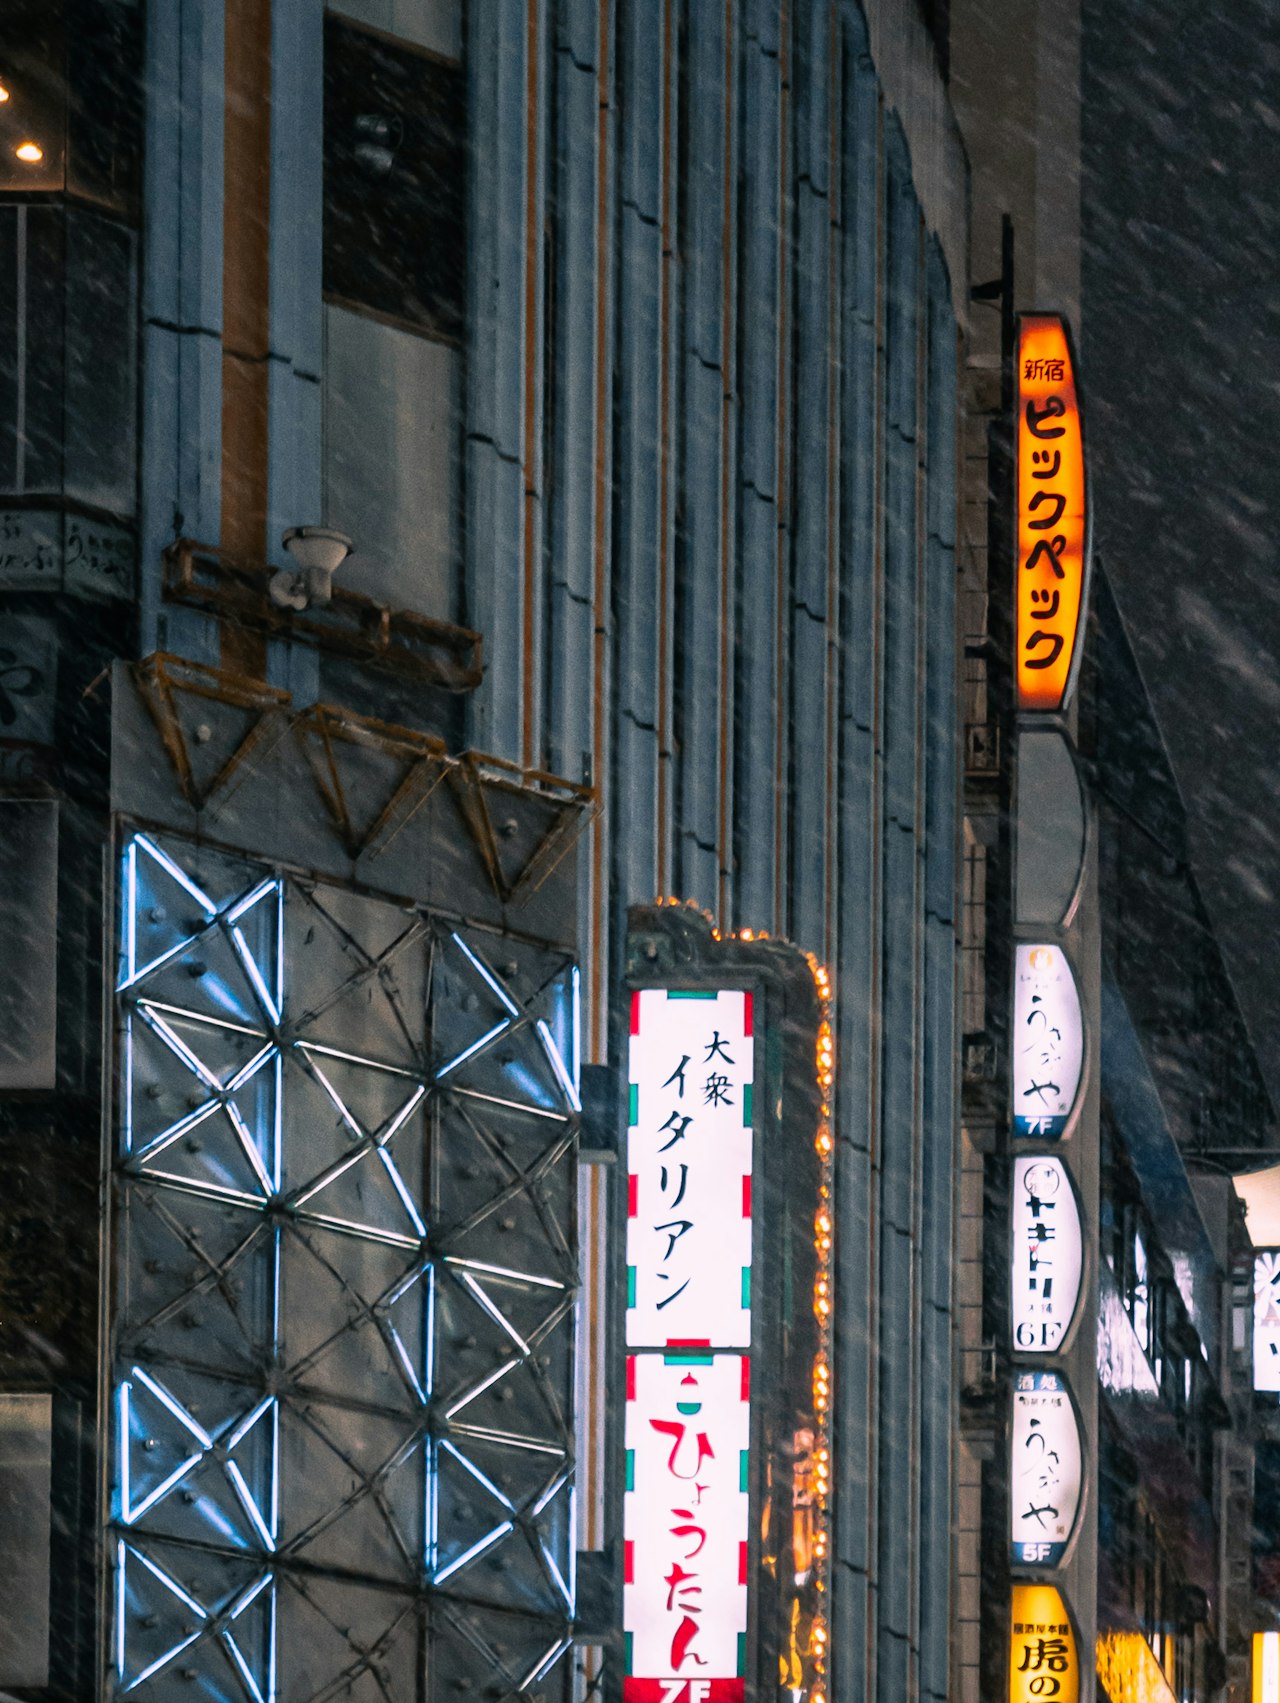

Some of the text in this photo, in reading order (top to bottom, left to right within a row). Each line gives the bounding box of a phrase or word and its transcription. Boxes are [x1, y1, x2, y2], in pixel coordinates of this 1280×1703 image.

[1024, 359, 1064, 382] 新宿
[703, 1030, 734, 1107] 大衆
[1024, 1119, 1053, 1135] 7F
[653, 1053, 696, 1310] イタリアン
[1017, 1323, 1062, 1346] 6F
[649, 1419, 716, 1672] ひょうたん
[1023, 1544, 1052, 1560] 5F
